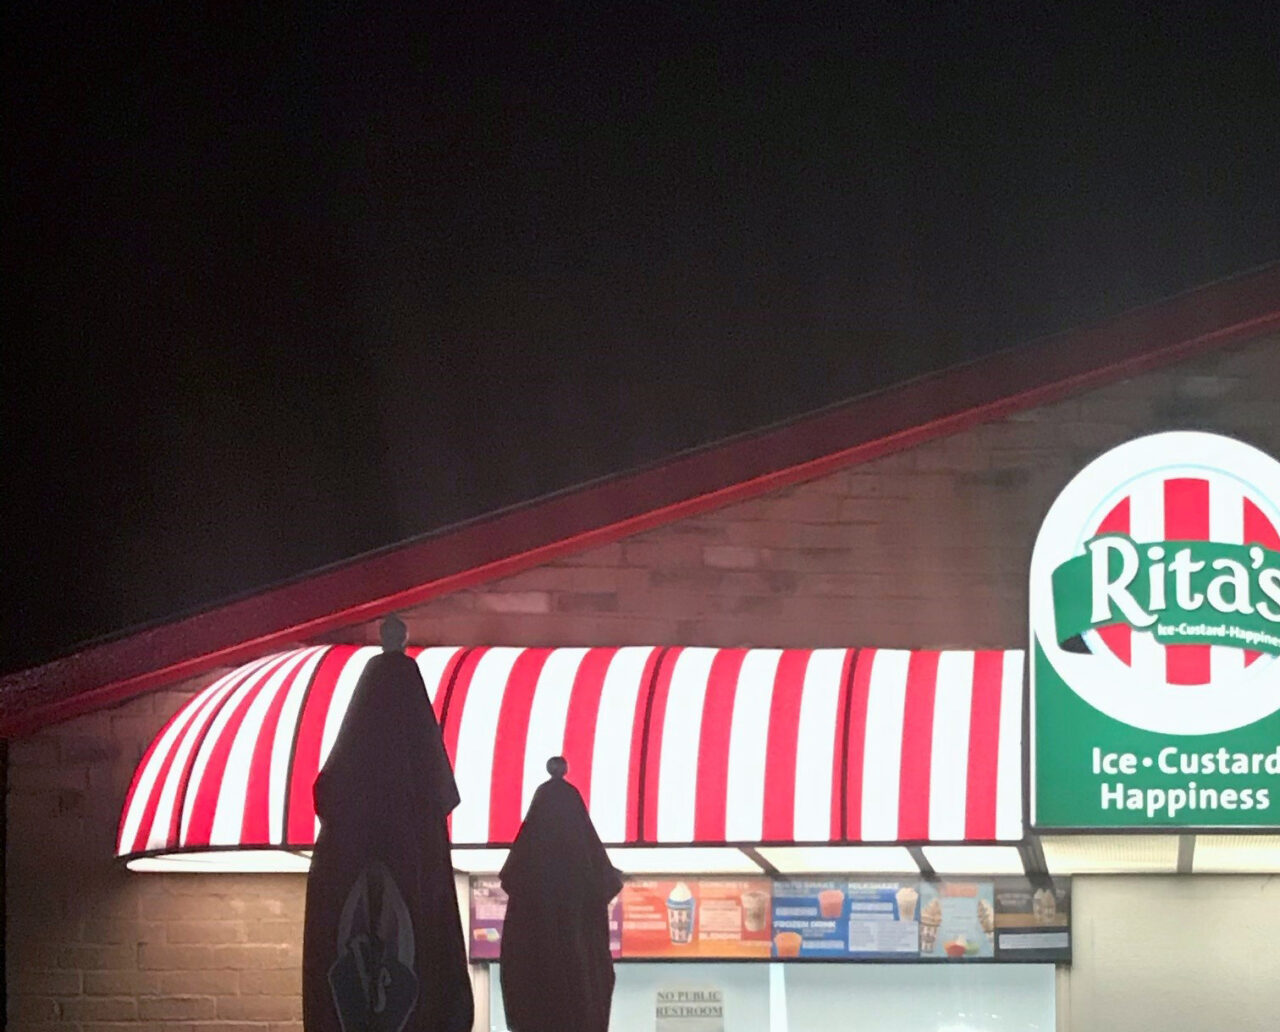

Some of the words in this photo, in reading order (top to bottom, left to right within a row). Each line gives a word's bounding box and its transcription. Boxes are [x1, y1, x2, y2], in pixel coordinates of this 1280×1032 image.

[1101, 782, 1270, 817] Happiness
[657, 991, 675, 1001] NO
[678, 991, 721, 1001] PUBLIC
[656, 1006, 723, 1016] RESTROOM
